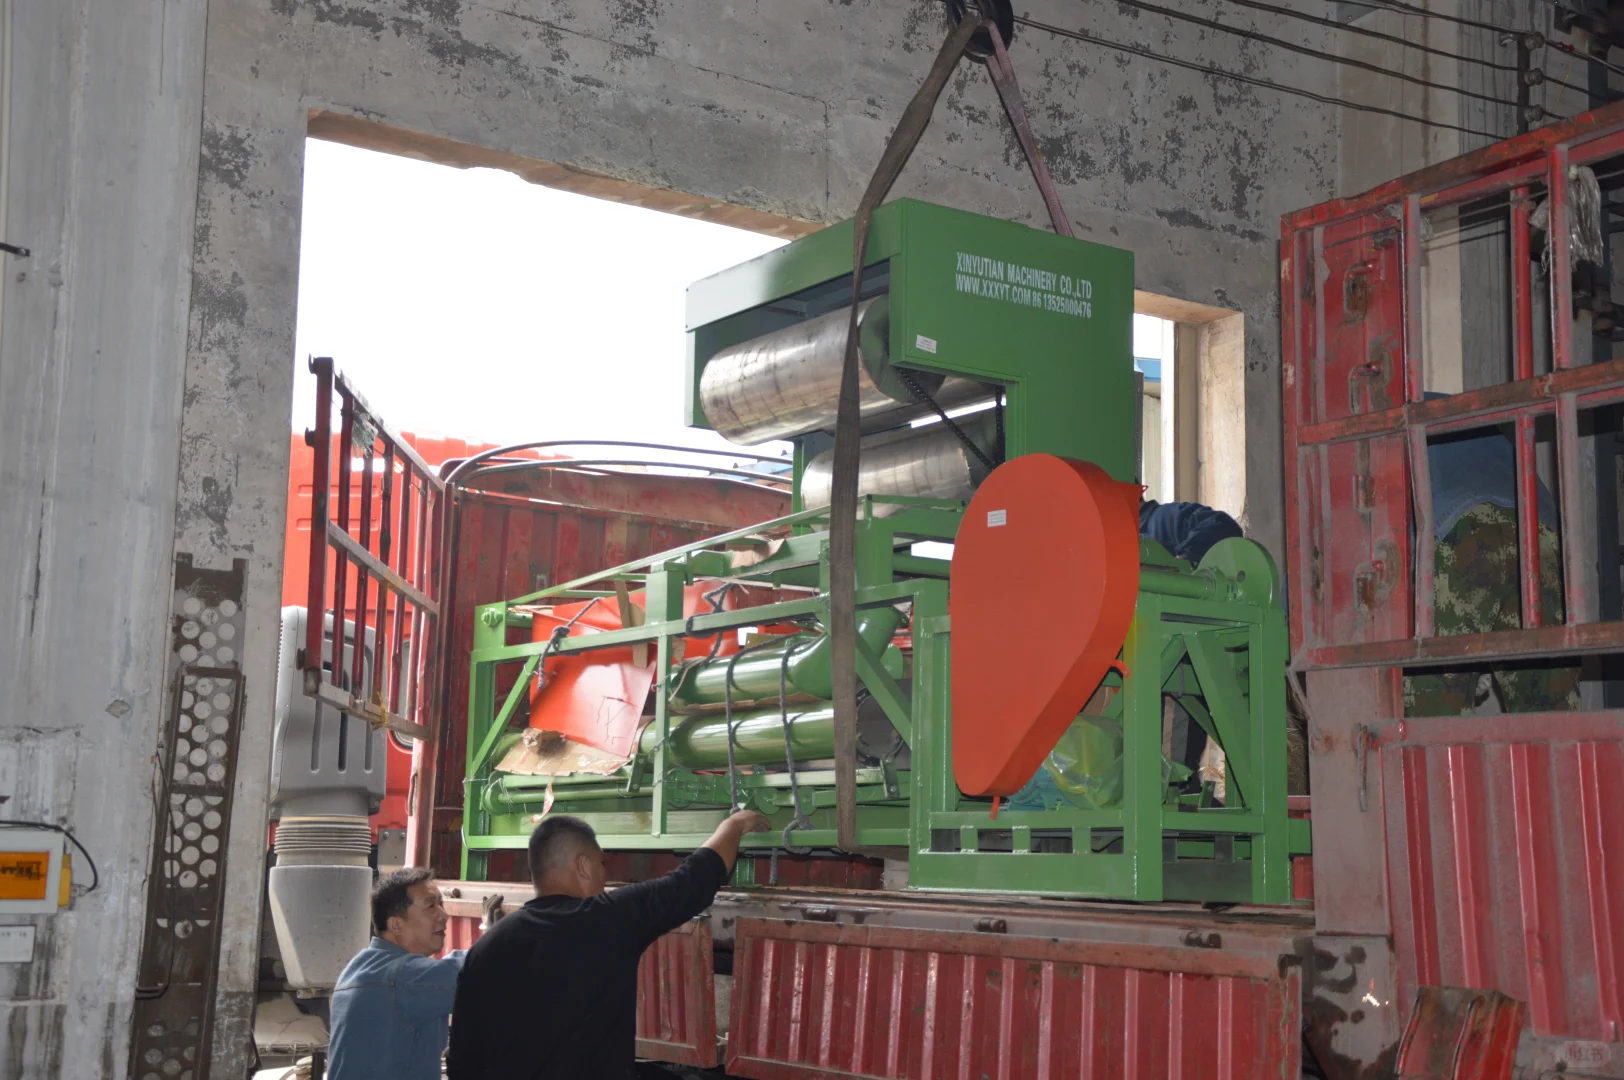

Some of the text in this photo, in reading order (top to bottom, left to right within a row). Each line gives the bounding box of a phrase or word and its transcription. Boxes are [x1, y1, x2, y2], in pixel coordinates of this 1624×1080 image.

[955, 273, 1092, 319] WWW.XXXYT.COM 86 13525000476
[956, 252, 1092, 299] XINYUTIAN MACHINERY CO.,LTD
